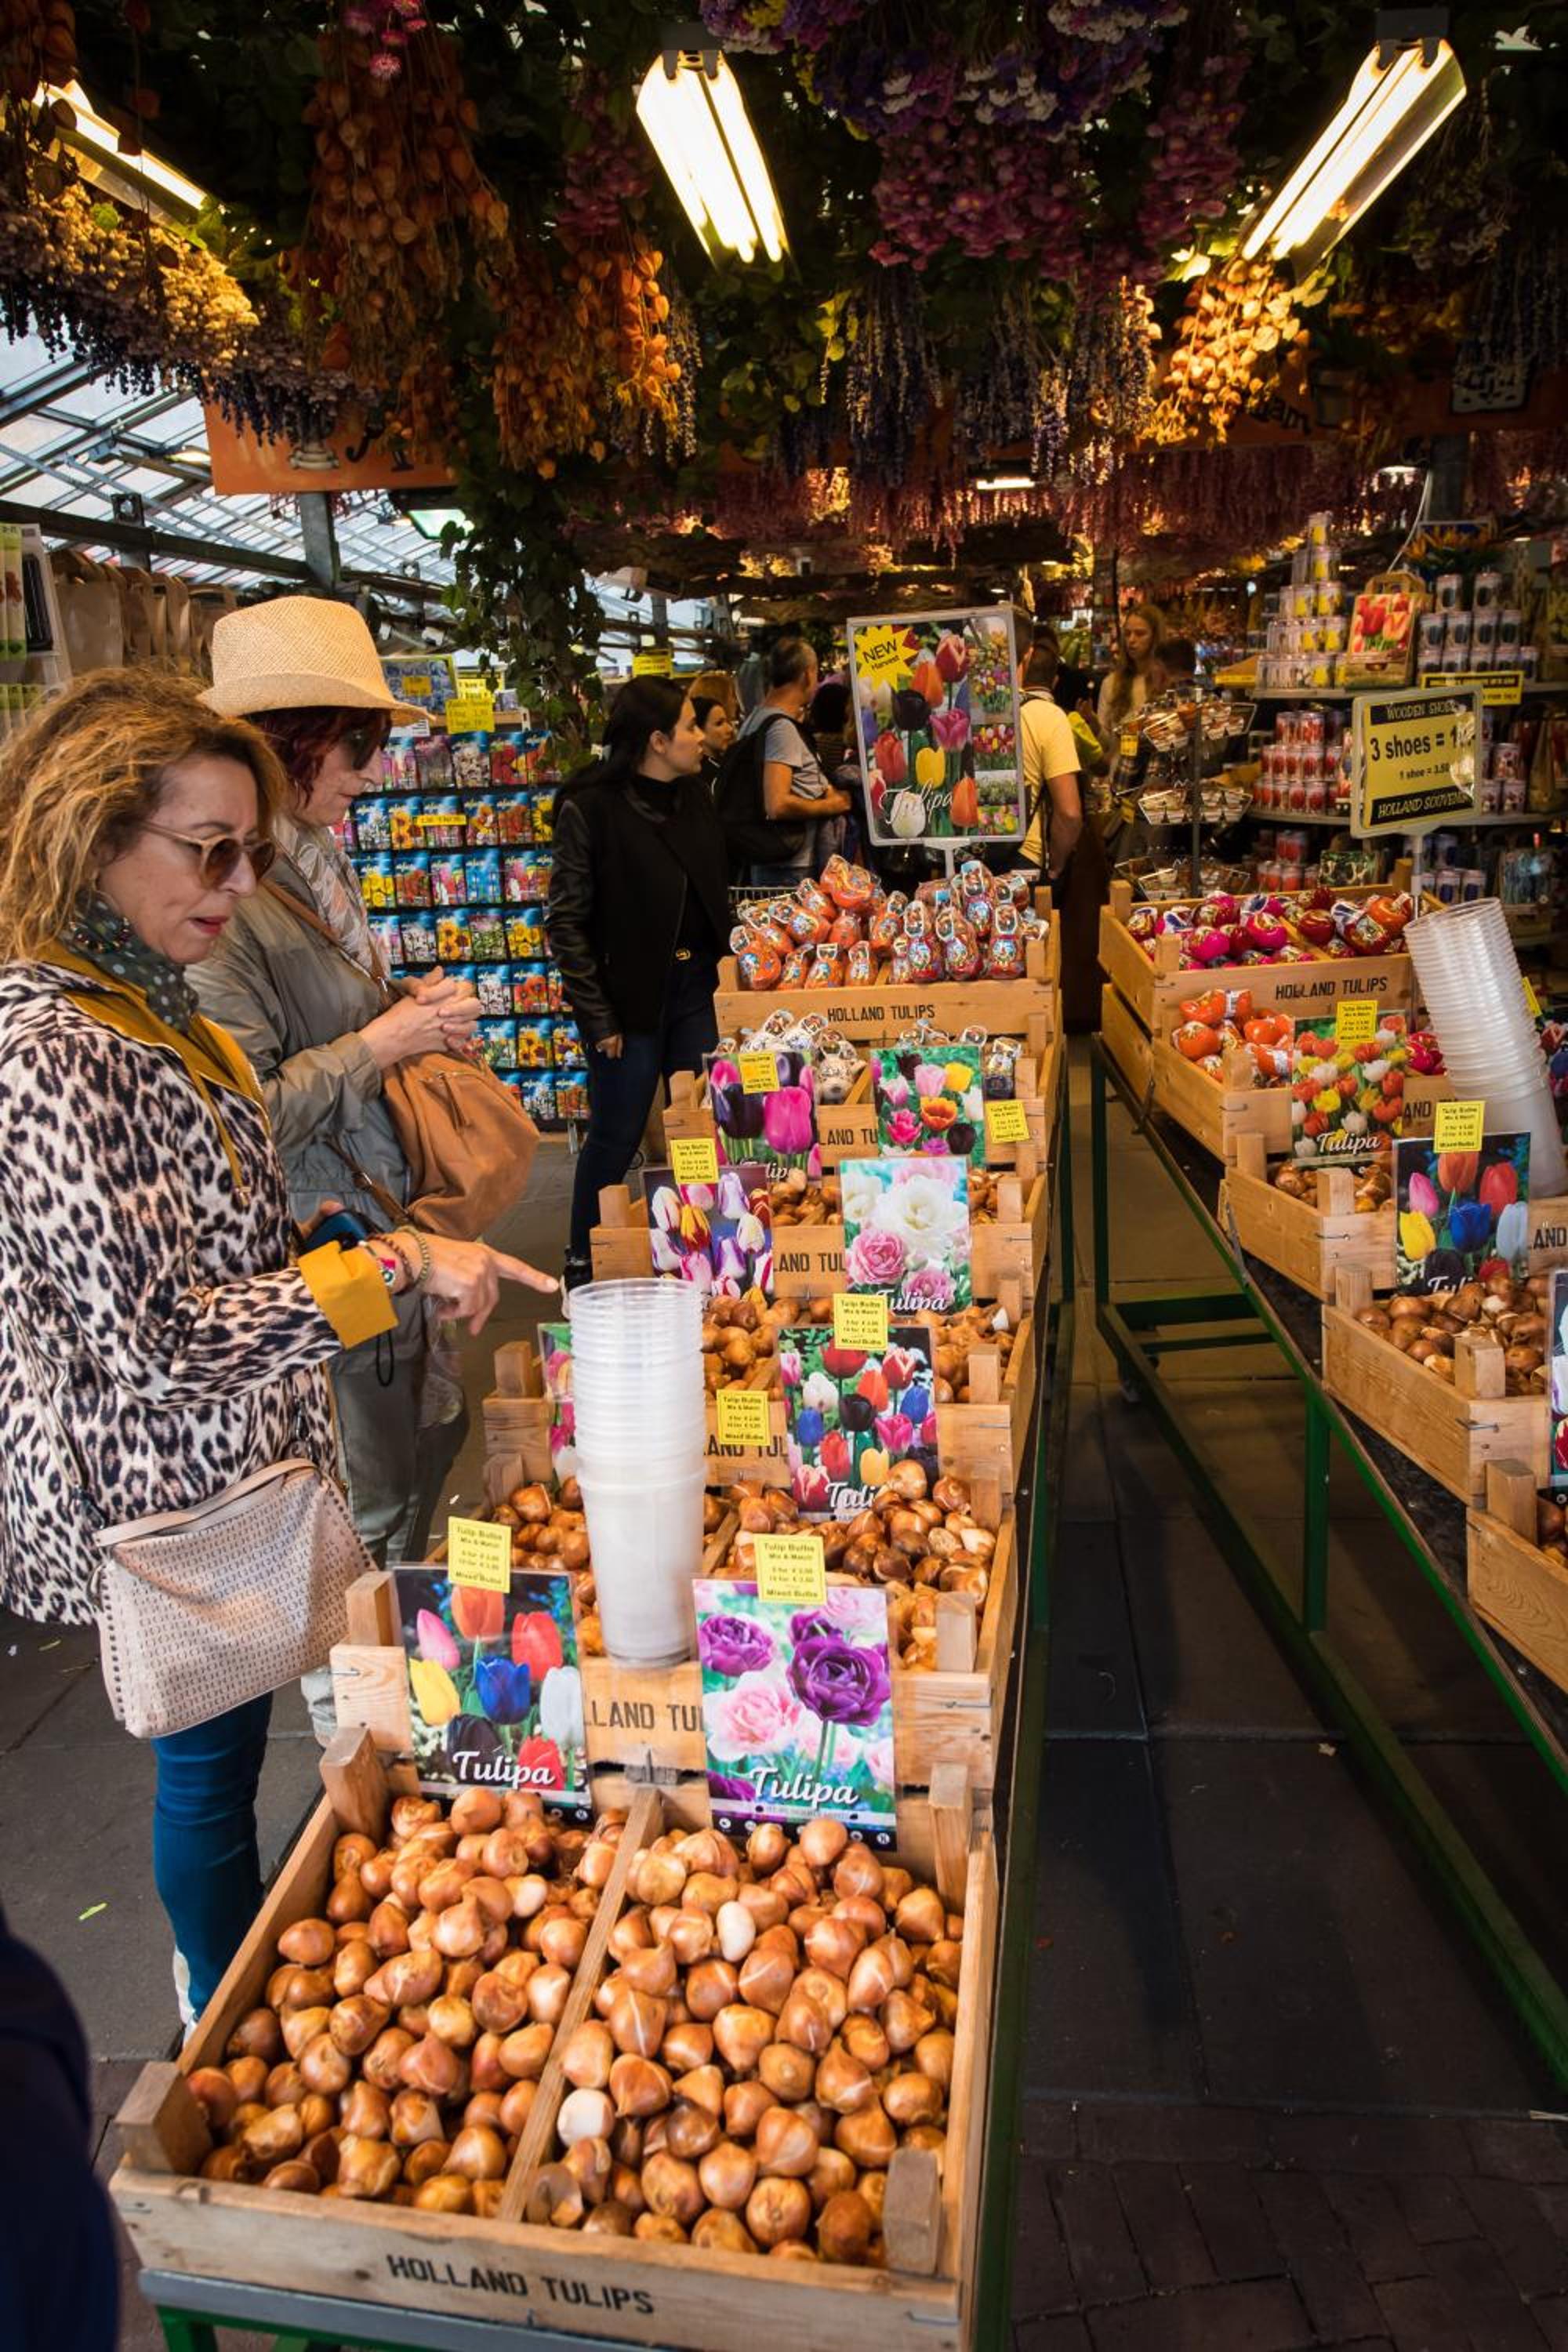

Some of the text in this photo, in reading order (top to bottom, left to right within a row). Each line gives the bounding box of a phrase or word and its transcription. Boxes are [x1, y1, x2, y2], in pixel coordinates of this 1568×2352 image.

[862, 638, 897, 663] NEW
[872, 655, 900, 670] Harvest
[1386, 702, 1425, 720] WOODEN
[1370, 738, 1381, 761] 3
[1386, 733, 1431, 759] shoes
[1436, 732, 1444, 746] =
[1406, 766, 1425, 779] shoe
[1378, 798, 1423, 818] HOLLAND
[1276, 976, 1388, 1000] HOLLAND TULIPS
[828, 1004, 935, 1022] HOLLAND TULIPS
[1316, 1132, 1380, 1155] Tulipa
[825, 1481, 877, 1509] Tuli
[585, 1699, 655, 1730] LAND
[452, 1750, 556, 1790] Tulipa
[746, 1766, 859, 1810] Tulipa
[386, 2254, 655, 2314] HOLLAND TULIPS
